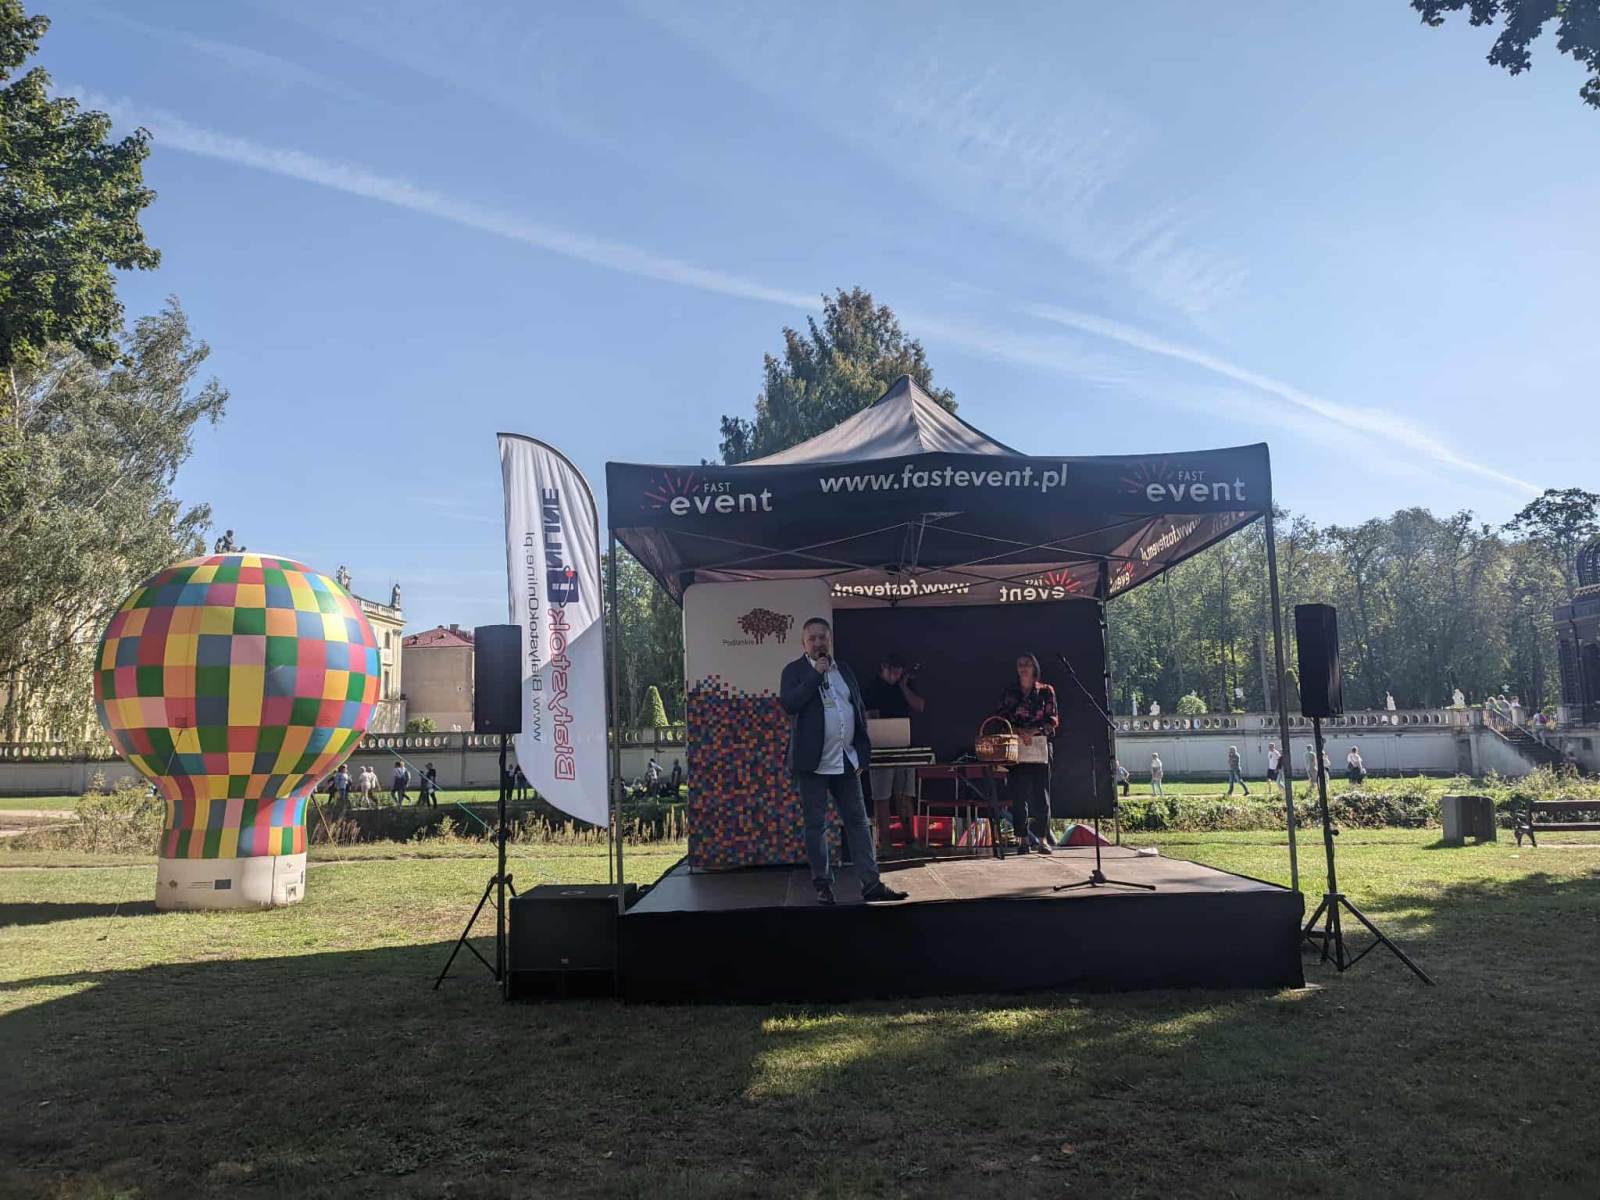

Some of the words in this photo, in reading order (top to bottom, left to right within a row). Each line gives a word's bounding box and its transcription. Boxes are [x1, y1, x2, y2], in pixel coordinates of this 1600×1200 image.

[703, 482, 732, 493] FAST
[819, 463, 1068, 493] www.fastevent.pl
[1178, 470, 1206, 481] FAST
[669, 487, 774, 516] event
[1146, 477, 1247, 502] event
